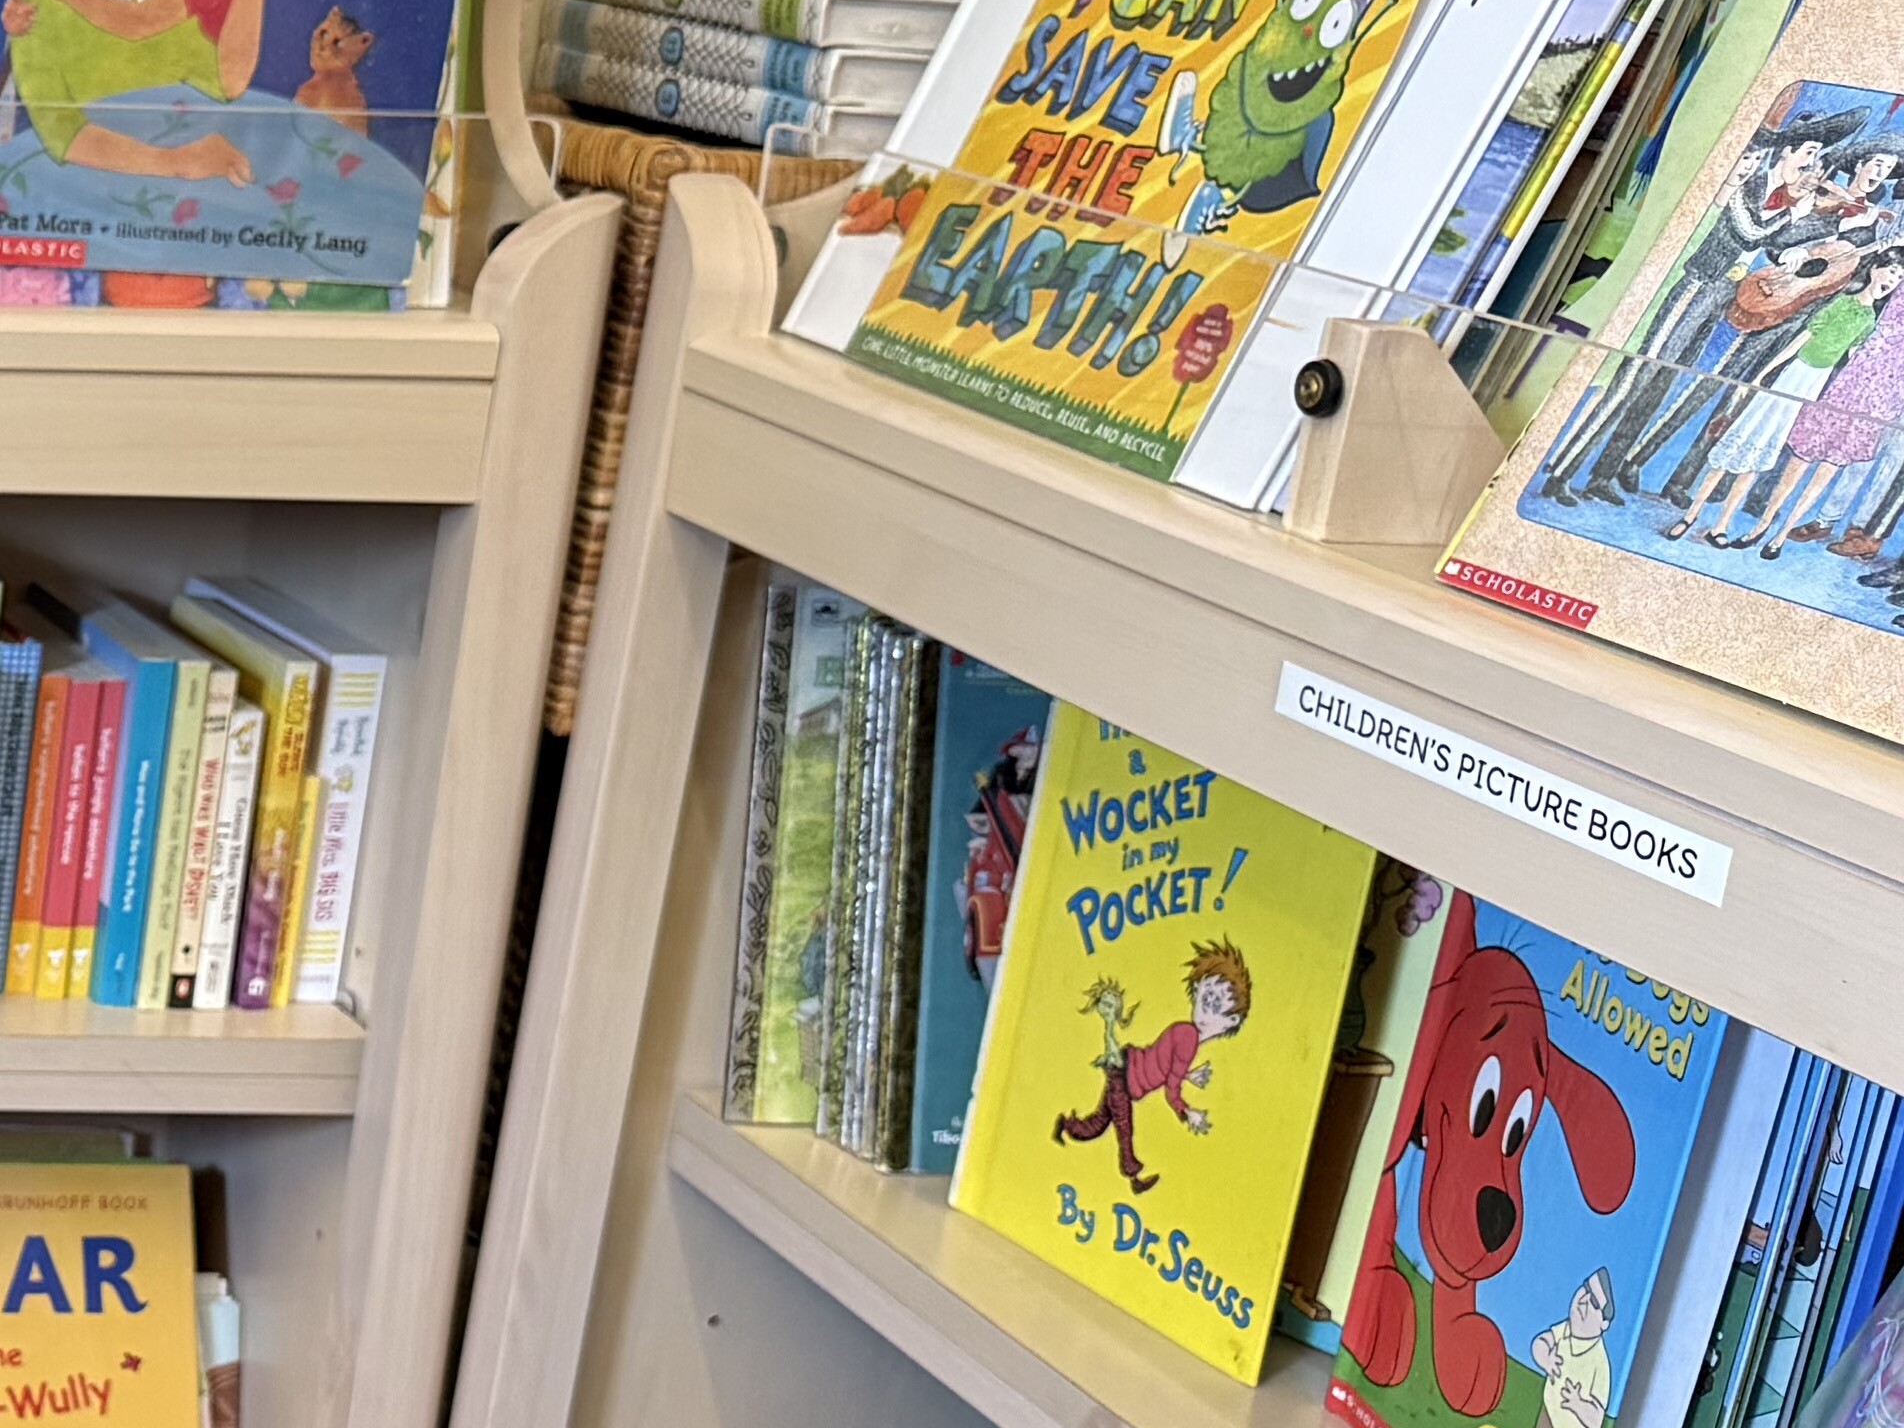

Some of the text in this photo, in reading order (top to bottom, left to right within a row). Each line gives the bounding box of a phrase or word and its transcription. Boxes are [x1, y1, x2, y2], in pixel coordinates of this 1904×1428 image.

[996, 14, 1175, 137] SAVE
[988, 127, 1158, 227] THE
[35, 214, 92, 235] Mora
[115, 223, 207, 243] illustrated
[210, 229, 234, 248] by
[237, 227, 307, 254] Cecily
[314, 236, 368, 256] Lang
[900, 203, 1204, 378] EARTH!
[1459, 561, 1599, 625] SCHOLASTIC
[1060, 769, 1218, 857] WOCKET
[1298, 684, 1699, 879] CHILDREN'S PICTURE BOOKS
[1066, 846, 1250, 957] POCKET!
[1560, 959, 1694, 1082] Allowed
[98, 1196, 149, 1211] BOOK
